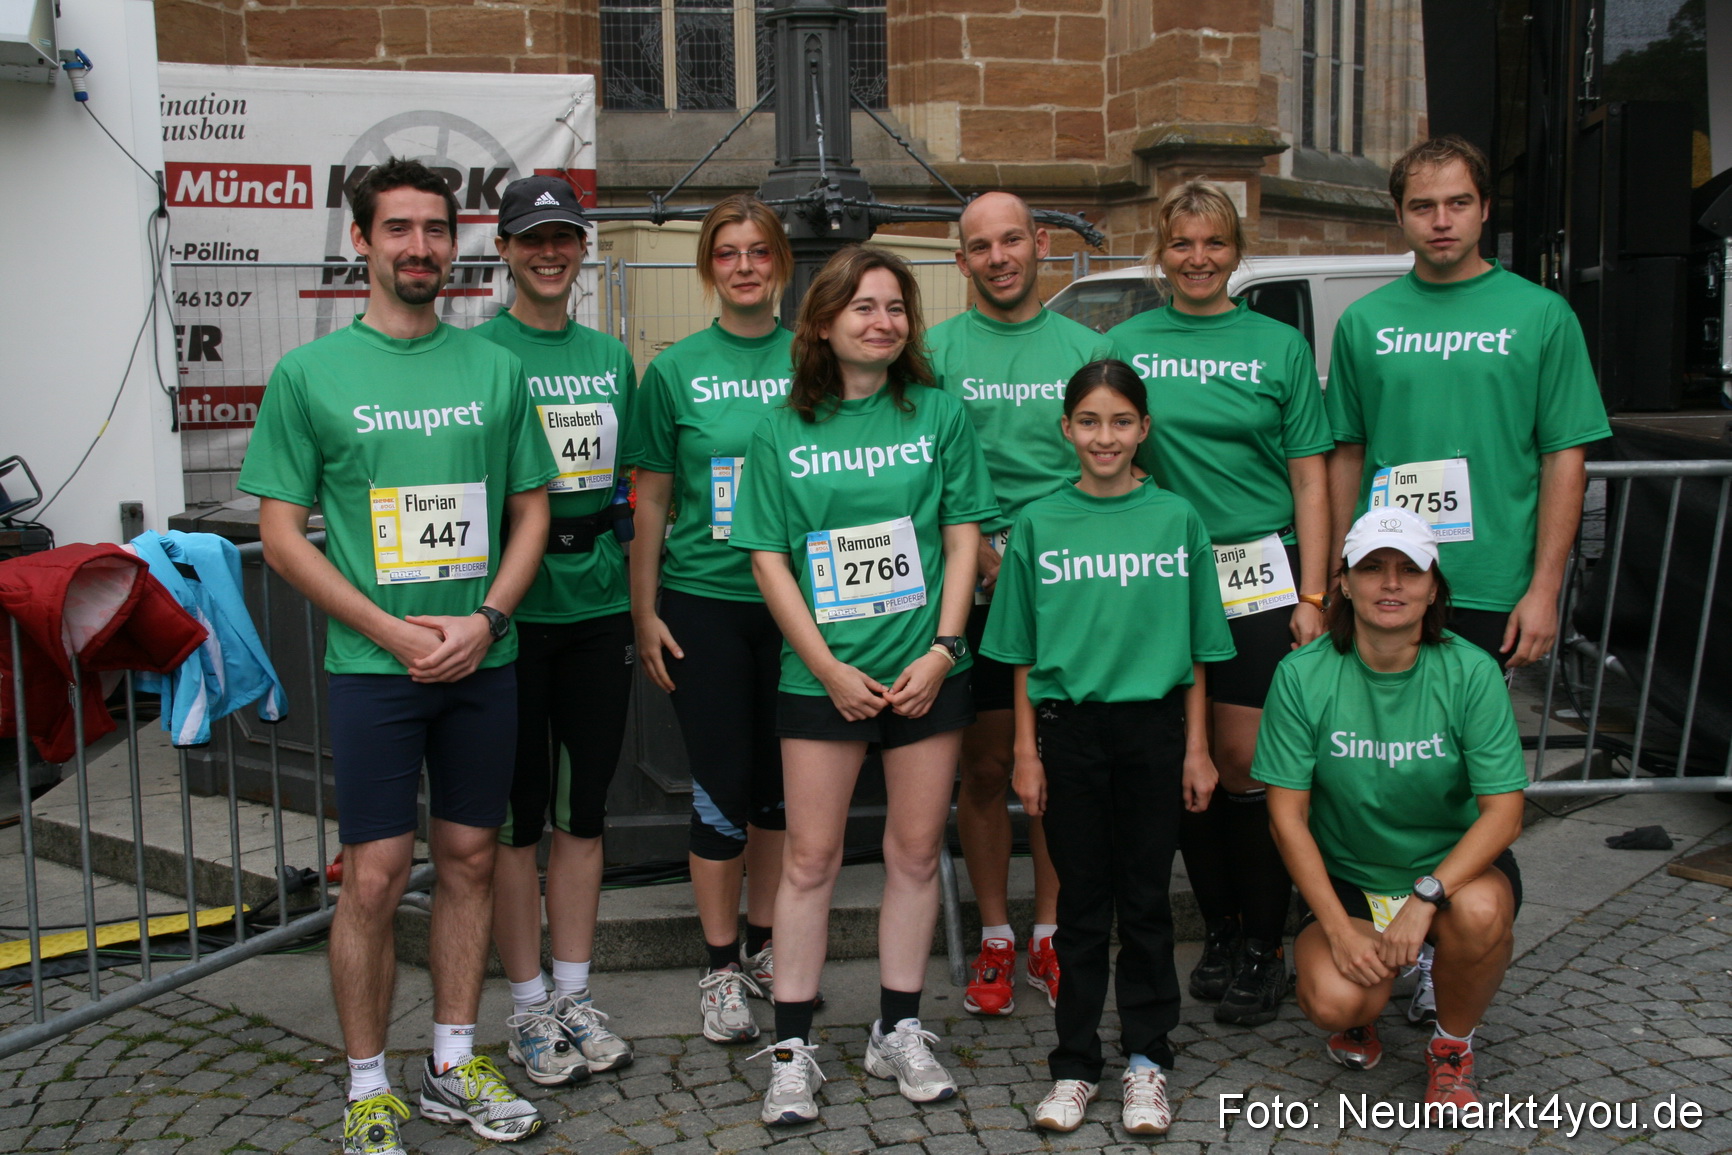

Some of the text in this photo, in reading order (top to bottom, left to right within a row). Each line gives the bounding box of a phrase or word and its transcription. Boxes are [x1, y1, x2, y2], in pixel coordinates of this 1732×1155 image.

[174, 165, 511, 209] Münch KRK
[548, 410, 603, 428] Elisabeth
[562, 436, 601, 461] 441
[1395, 471, 1417, 485] Tom
[405, 494, 456, 512] Florian
[1395, 490, 1458, 514] 2755
[379, 521, 470, 548] C 447
[837, 535, 891, 552] Ramona
[1038, 545, 1189, 586] Sinupret
[1213, 547, 1246, 564] Tanja
[450, 562, 487, 572] PFLEIDERER
[817, 553, 910, 586] B 2766
[1228, 562, 1274, 590] 445
[885, 592, 925, 608] PFLEIDERER
